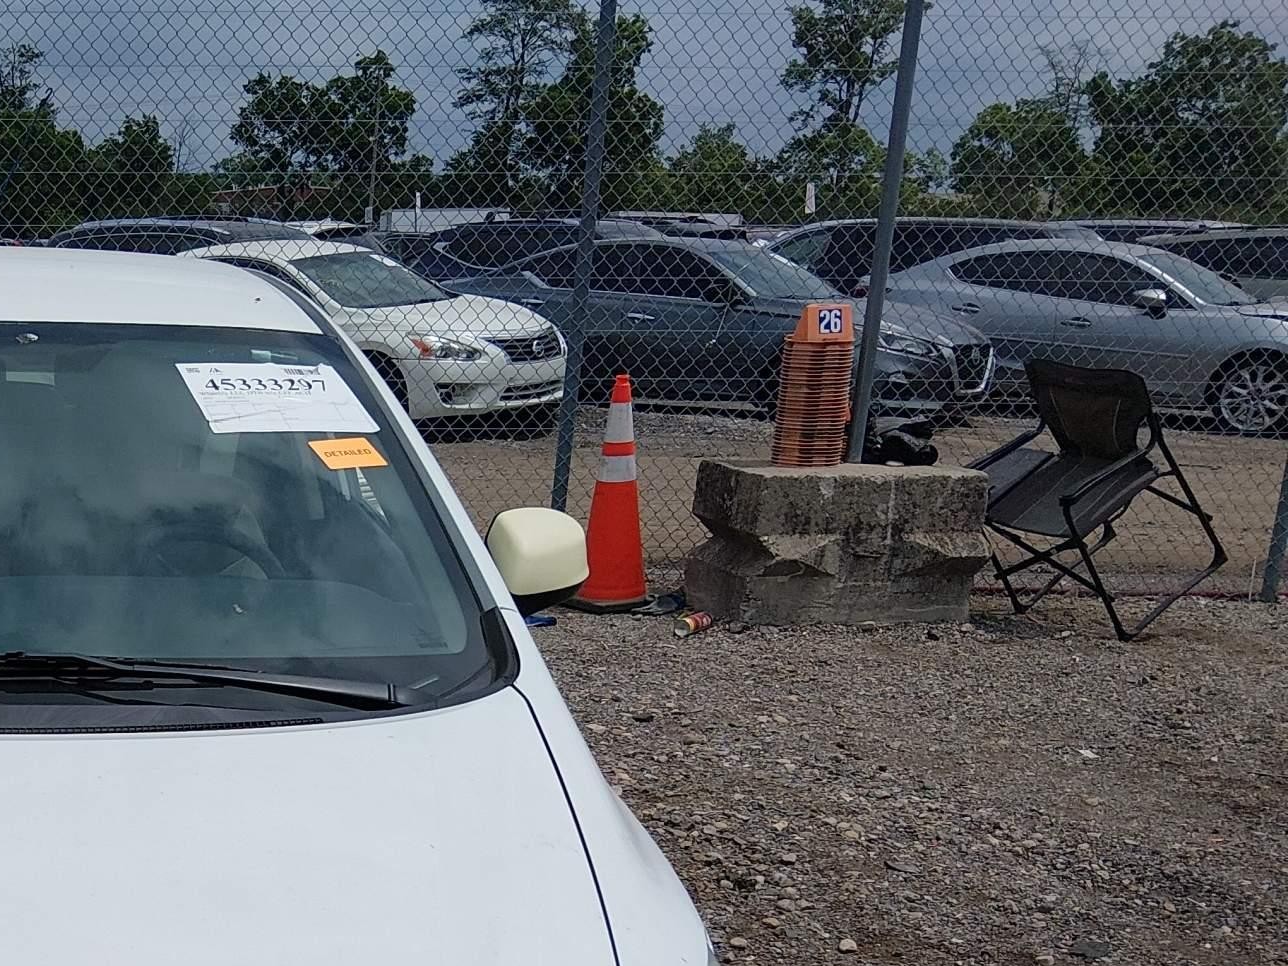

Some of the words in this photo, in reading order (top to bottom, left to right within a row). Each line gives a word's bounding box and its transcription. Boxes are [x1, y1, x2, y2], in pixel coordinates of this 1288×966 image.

[819, 310, 841, 334] 26
[205, 378, 327, 392] 45333297
[323, 448, 372, 459] DETAILED
